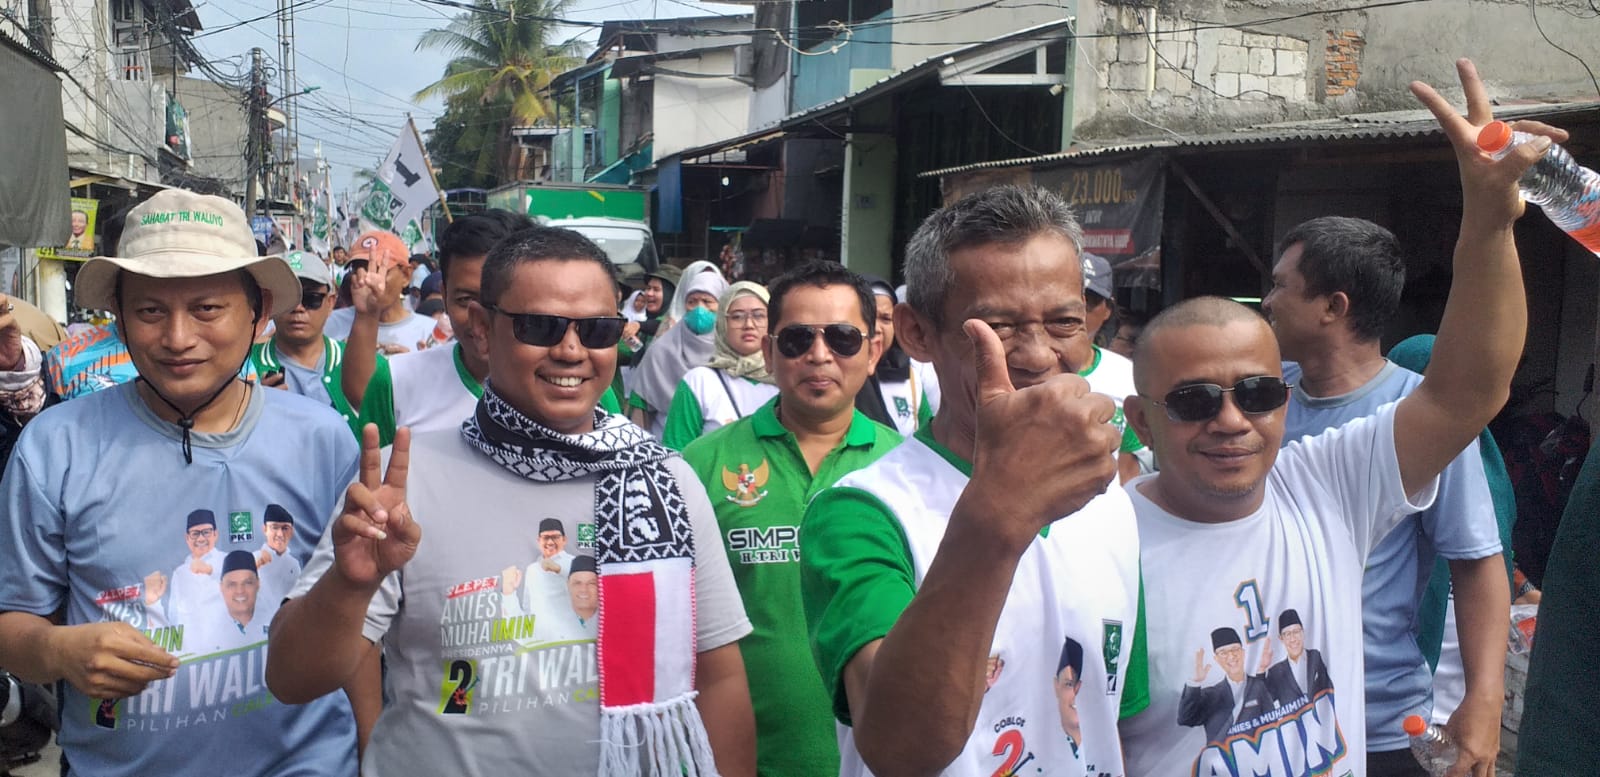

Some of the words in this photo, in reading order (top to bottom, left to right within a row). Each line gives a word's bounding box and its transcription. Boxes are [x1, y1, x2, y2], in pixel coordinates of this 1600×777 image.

[1072, 169, 1121, 205] 23.000
[141, 212, 176, 225] SAHABAT
[179, 210, 190, 222] TRI
[193, 210, 223, 227] WALUYO
[231, 533, 252, 541] PKB
[447, 576, 499, 597] SLEPET
[441, 592, 498, 624] ANIES
[1235, 579, 1269, 643] 1
[441, 614, 536, 648] MUHAIMIN
[442, 643, 513, 658] PRESIDENNYA
[443, 660, 473, 714] 2
[480, 652, 529, 698] TRI
[127, 709, 227, 731] PILIHAN
[479, 693, 569, 714] PILIHAN
[1228, 720, 1252, 735] ANIES
[1252, 718, 1260, 727] &
[1260, 695, 1309, 724] MUHAIMIN
[1196, 690, 1343, 777] AMIN
[991, 729, 1025, 777] 2
